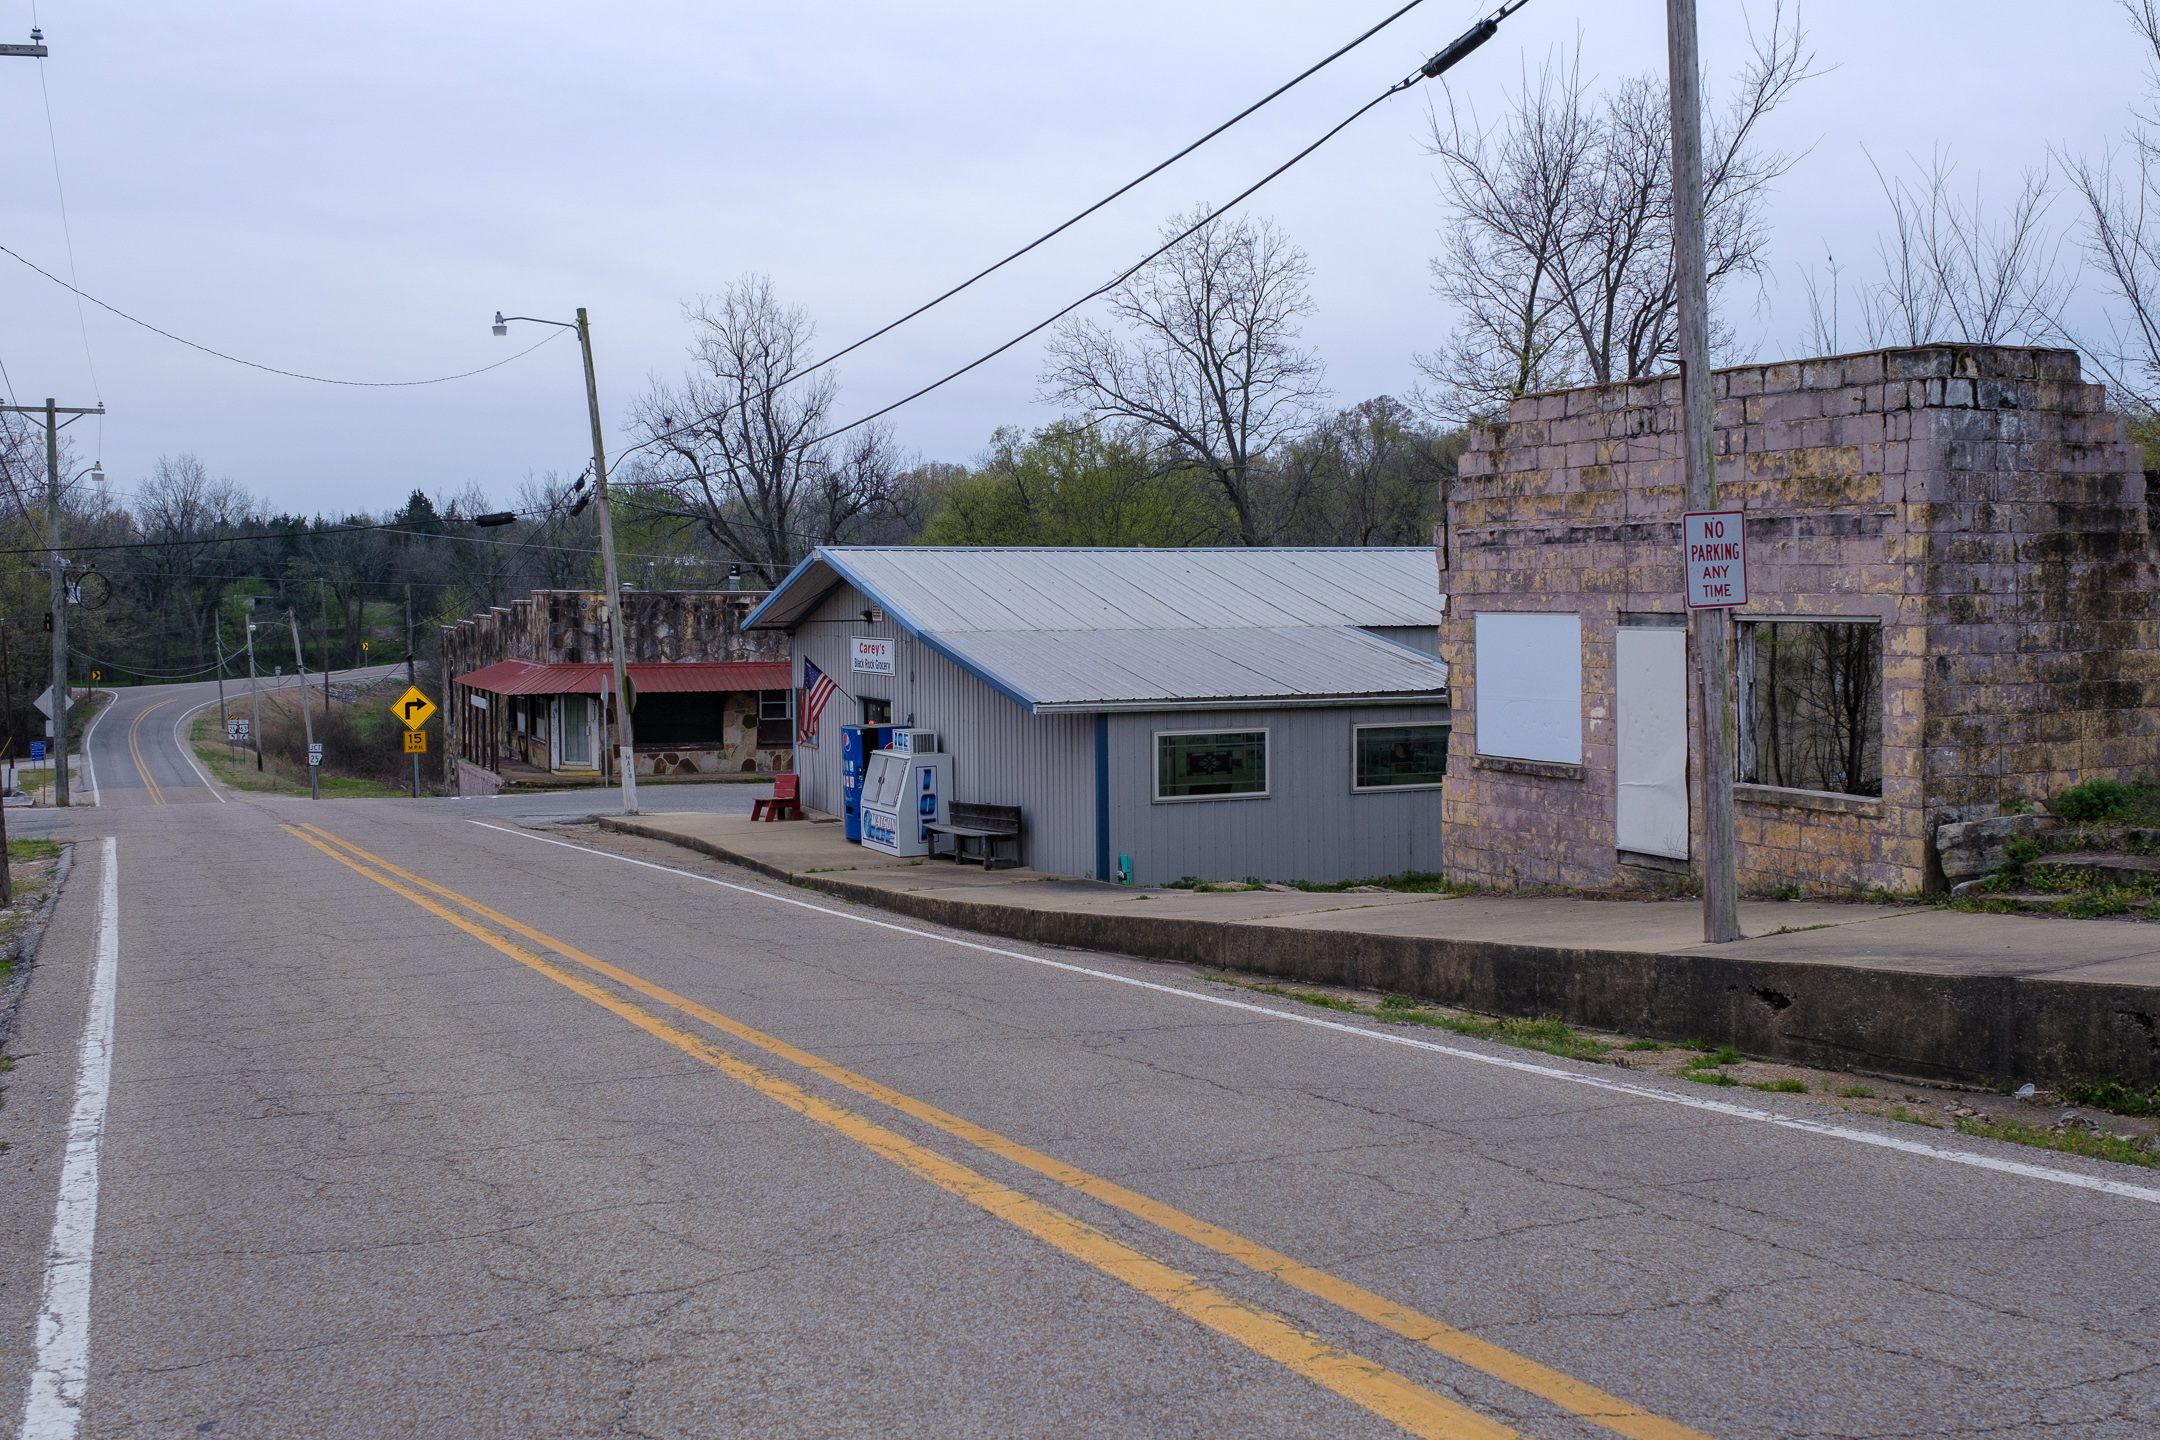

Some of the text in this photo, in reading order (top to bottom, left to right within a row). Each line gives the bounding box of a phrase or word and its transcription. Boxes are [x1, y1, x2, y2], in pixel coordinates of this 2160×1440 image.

[1704, 521, 1724, 539] NO
[1691, 542, 1740, 562] PARKING
[1703, 565, 1730, 579] ANY
[1703, 583, 1732, 598] TIME
[859, 642, 885, 656] Carey's
[408, 733, 422, 744] 15
[894, 732, 909, 748] ICE
[310, 754, 320, 764] 25
[871, 812, 895, 832] WATSON
